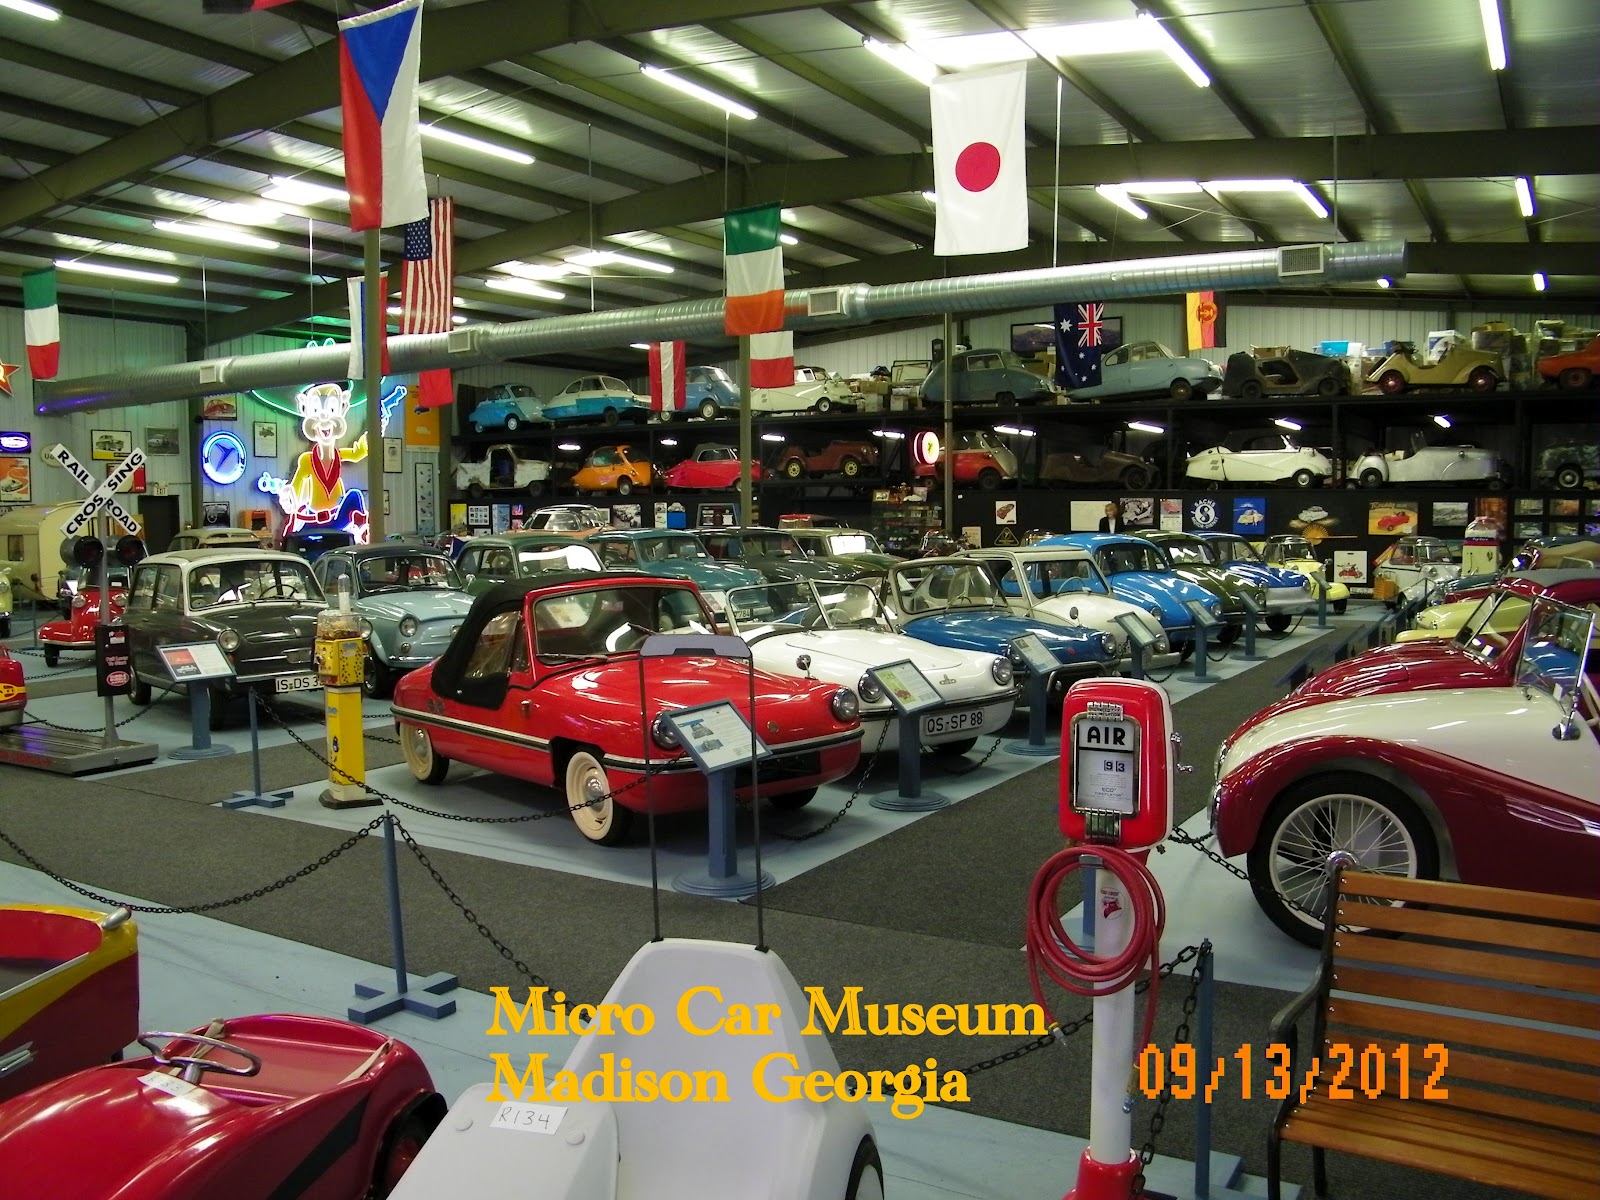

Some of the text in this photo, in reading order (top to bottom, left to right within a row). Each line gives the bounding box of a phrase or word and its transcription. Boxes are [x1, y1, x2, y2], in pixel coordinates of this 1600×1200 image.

[57, 449, 92, 486] RAIL
[104, 497, 138, 533] ROAD
[970, 711, 983, 726] 88
[1087, 726, 1126, 746] AIR
[498, 1106, 551, 1130] R134
